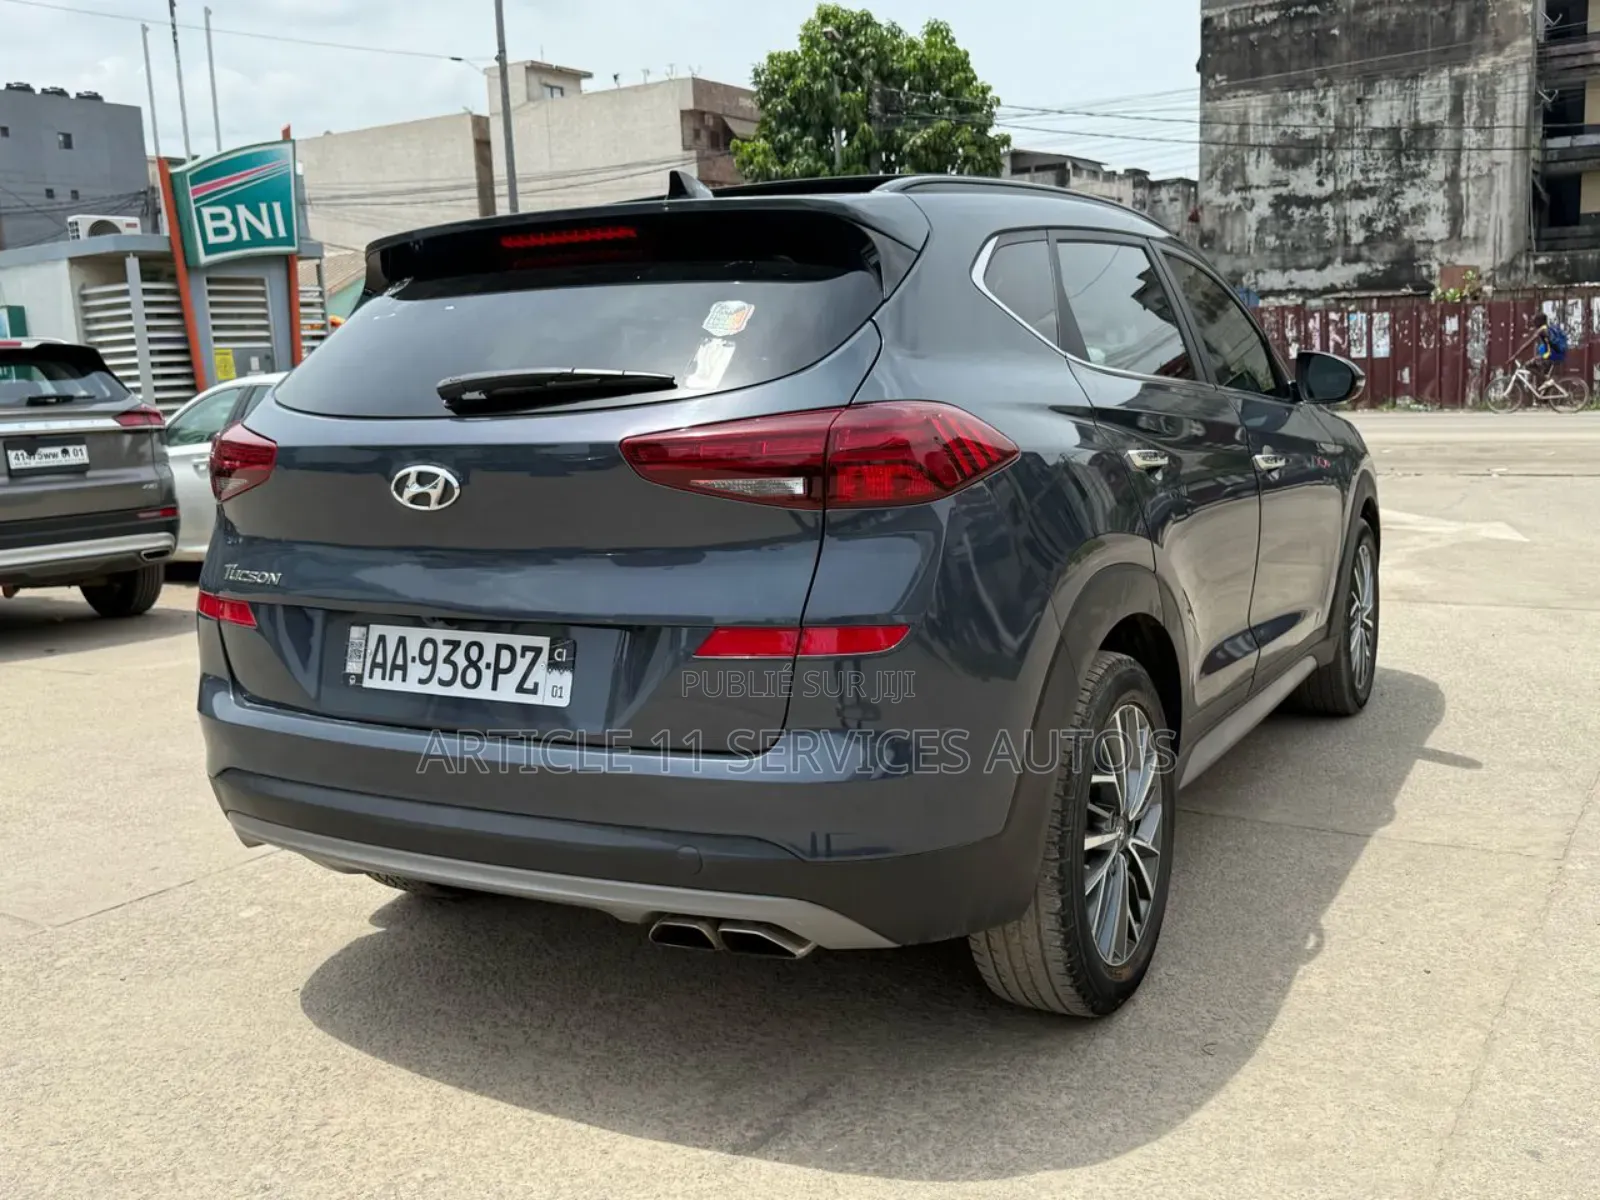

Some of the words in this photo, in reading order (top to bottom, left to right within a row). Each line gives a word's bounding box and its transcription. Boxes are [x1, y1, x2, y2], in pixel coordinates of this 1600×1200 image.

[201, 201, 288, 244] BNI
[554, 648, 567, 662] CI
[551, 684, 564, 699] 01
